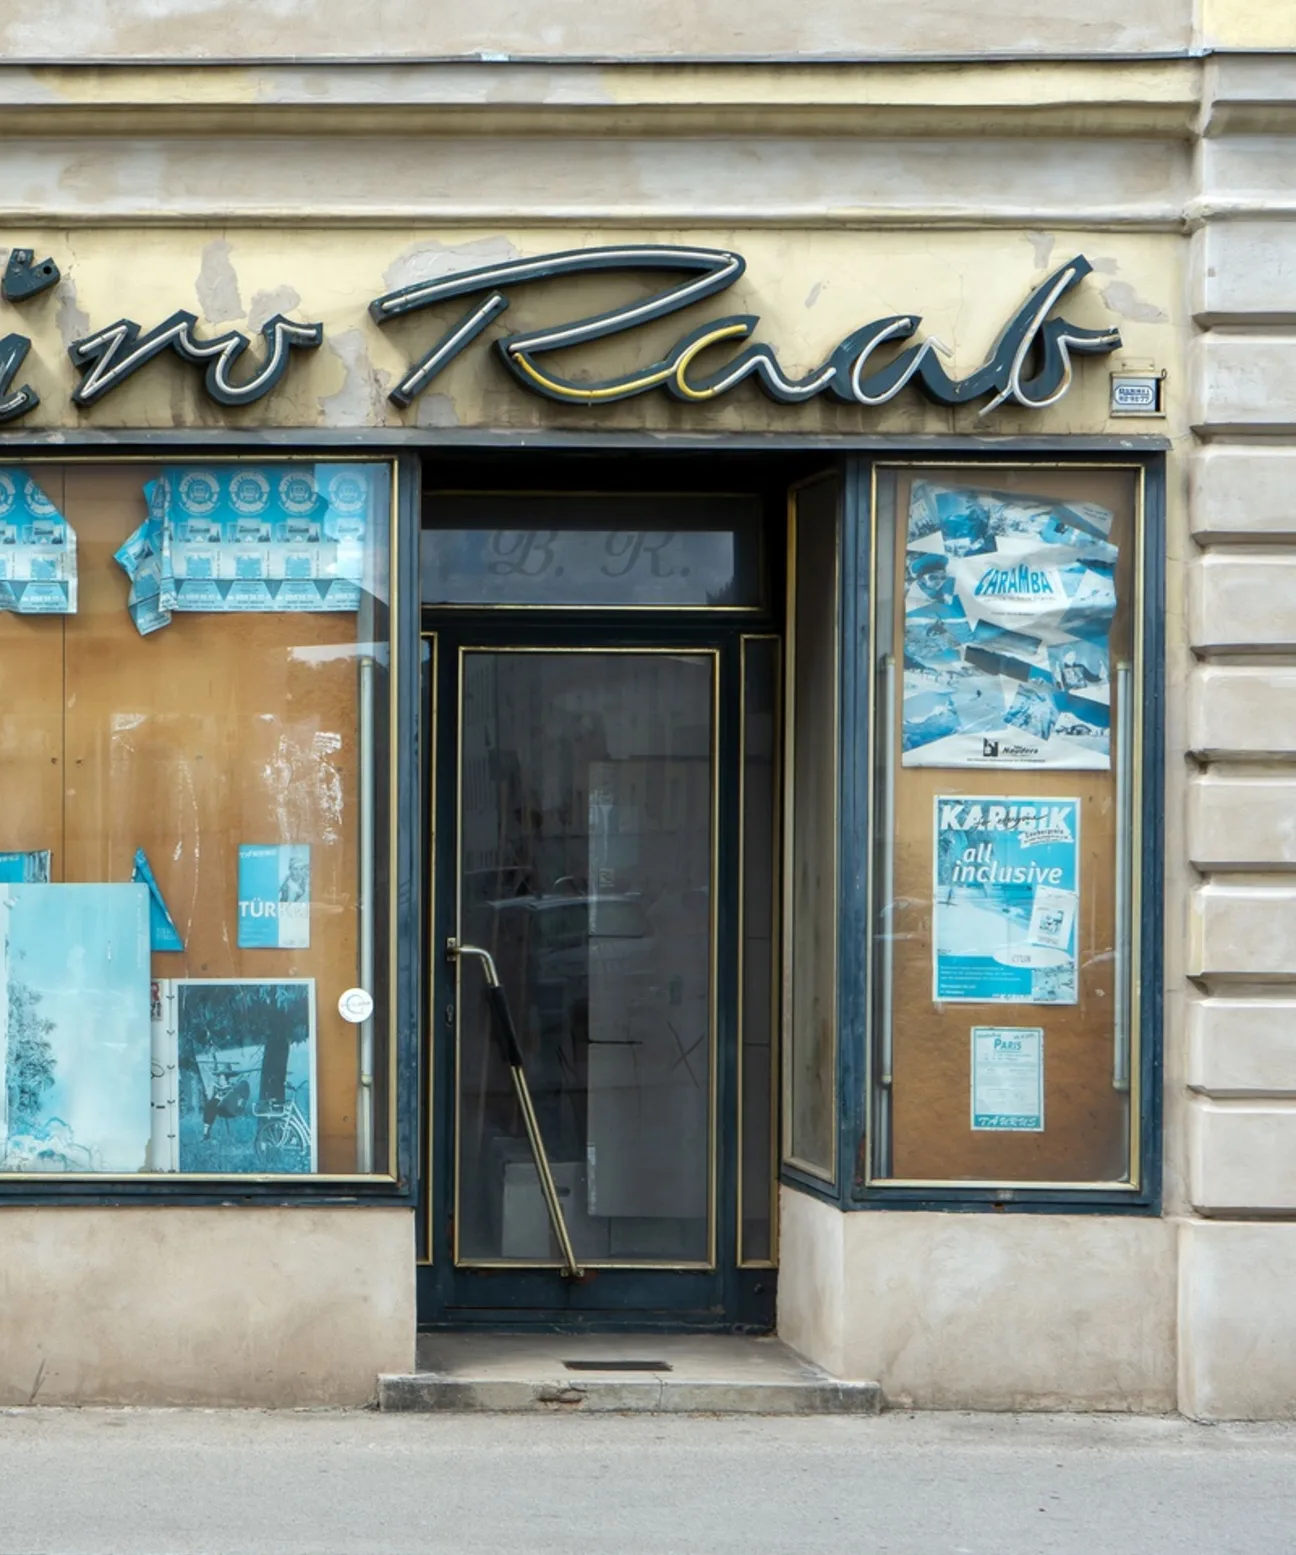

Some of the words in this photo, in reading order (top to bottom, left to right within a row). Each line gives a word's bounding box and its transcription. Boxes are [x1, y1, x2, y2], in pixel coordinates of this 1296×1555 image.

[368, 244, 1122, 409] Raab
[974, 563, 1053, 595] CARAMBA
[941, 804, 1071, 831] KARIBIK
[963, 843, 993, 864] all
[952, 860, 1064, 884] inclusive
